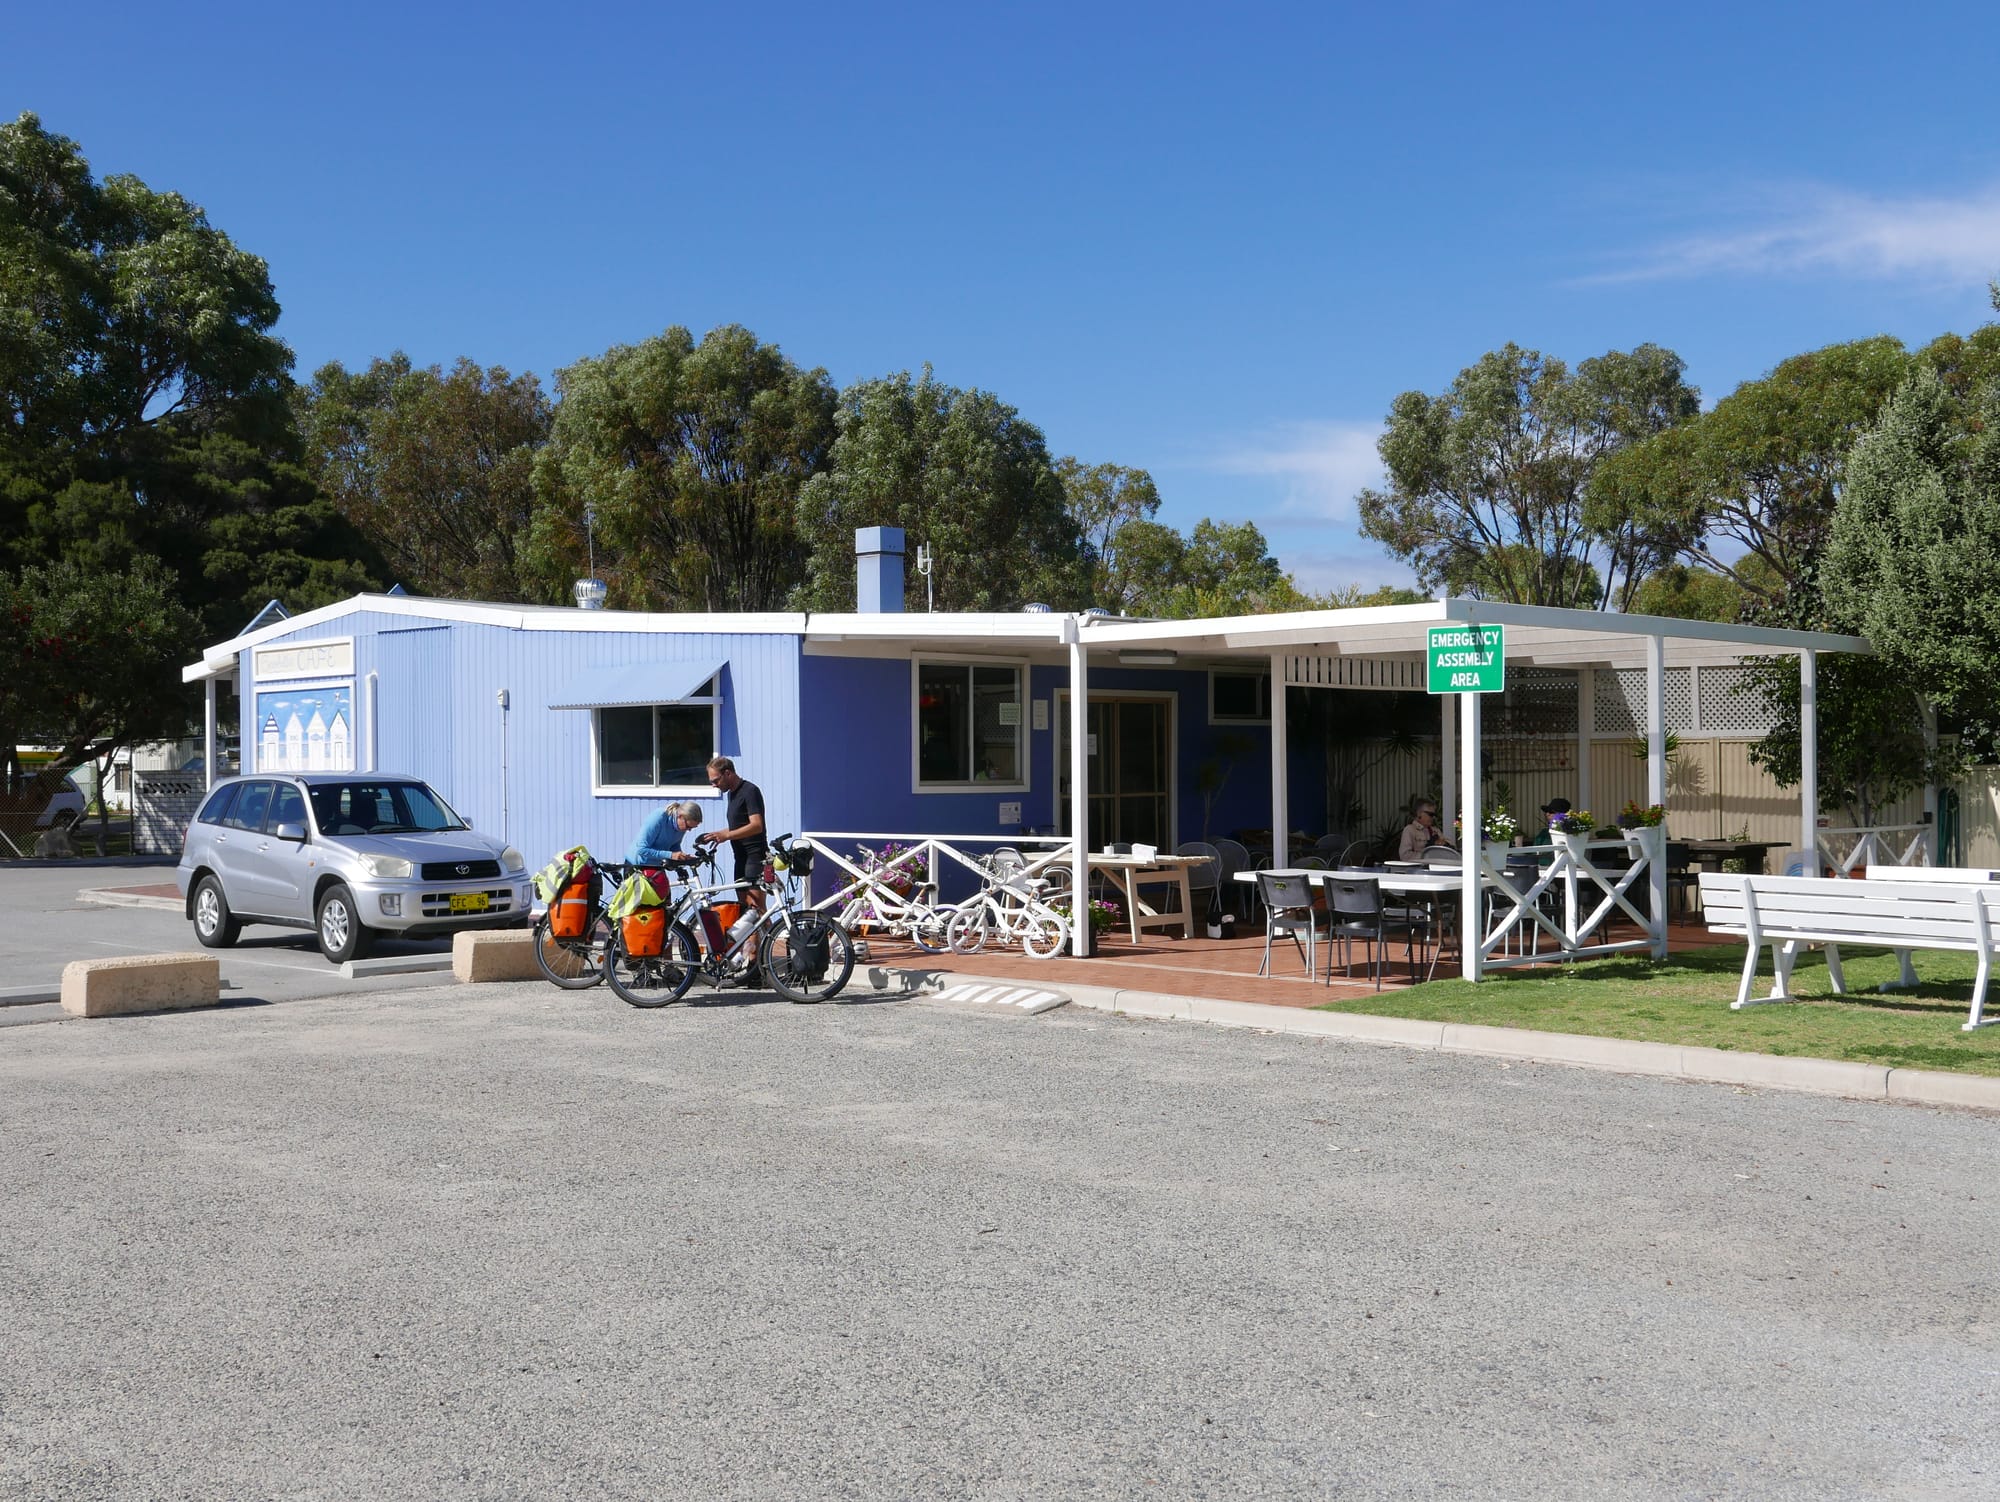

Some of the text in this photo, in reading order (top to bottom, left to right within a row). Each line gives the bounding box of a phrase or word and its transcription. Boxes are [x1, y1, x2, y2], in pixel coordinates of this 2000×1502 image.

[1431, 631, 1500, 648] EMERGENCY
[1436, 651, 1494, 667] ASSEMBLY
[1450, 672, 1481, 687] AREA
